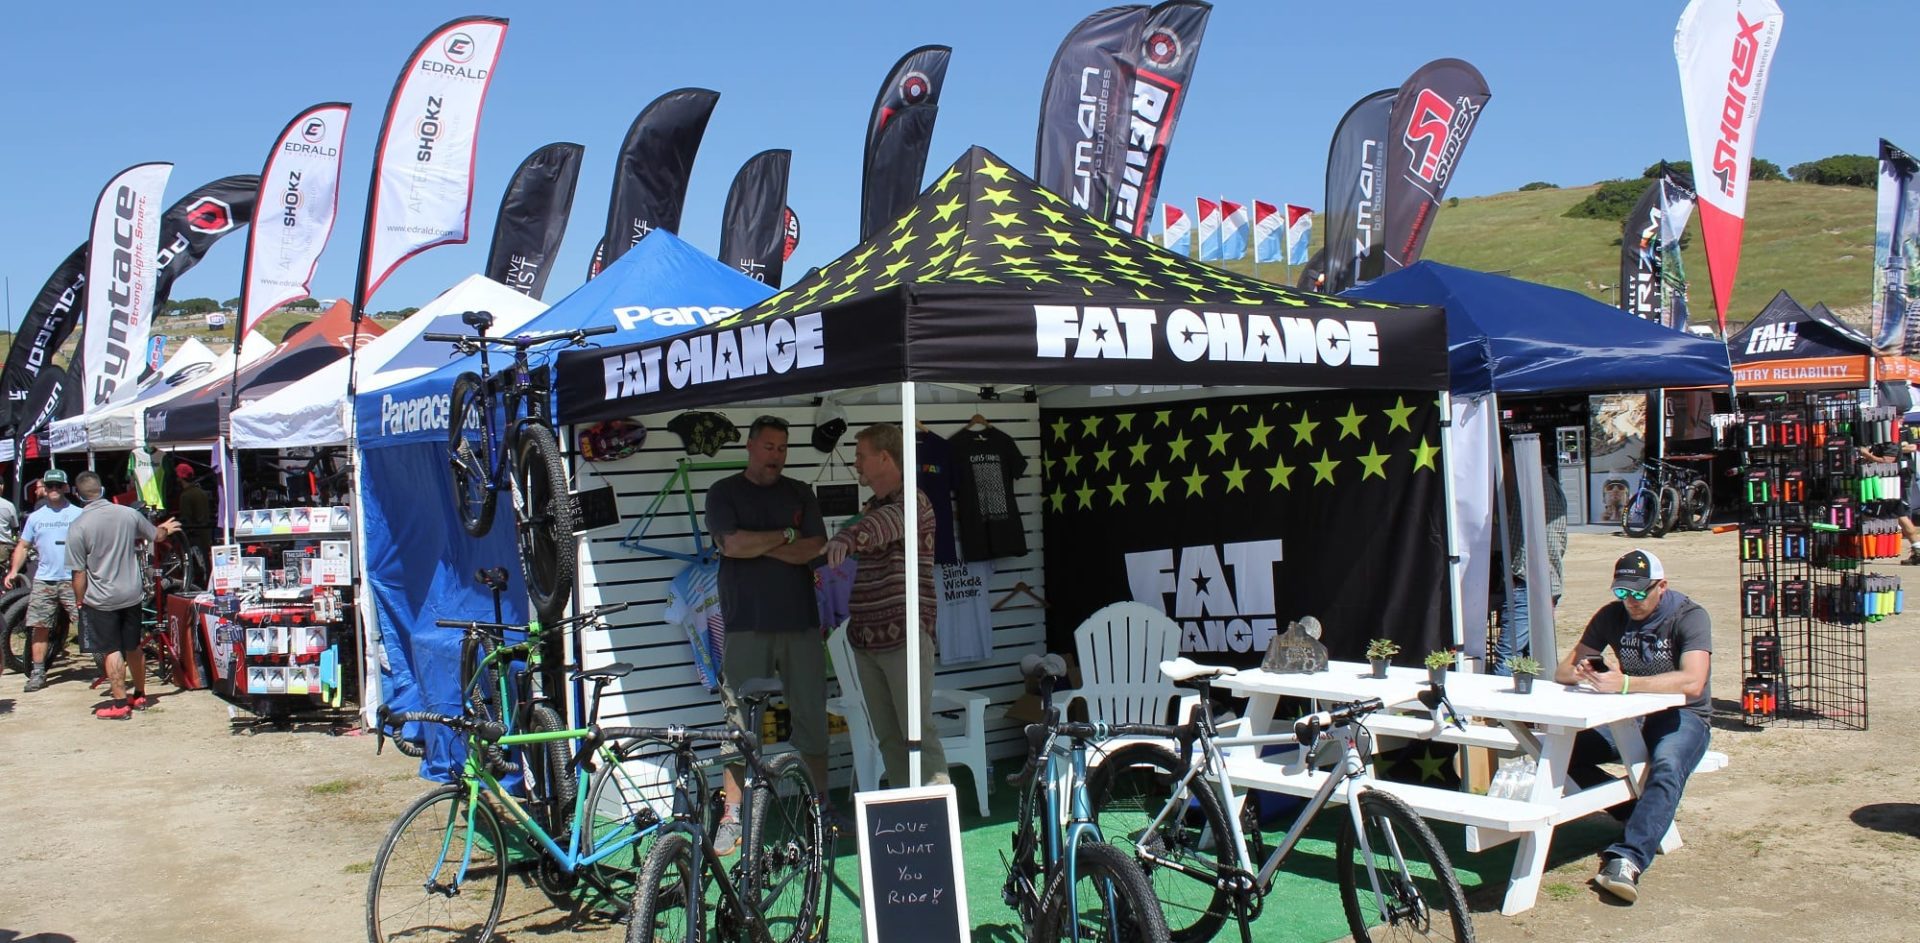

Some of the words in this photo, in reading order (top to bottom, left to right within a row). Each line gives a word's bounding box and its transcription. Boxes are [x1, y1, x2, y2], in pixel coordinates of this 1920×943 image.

[421, 60, 488, 80] EDRALD
[1093, 69, 1112, 154] boundless
[285, 142, 337, 157] EDRALD
[134, 195, 147, 240] Smart.
[133, 242, 145, 281] Light.
[1637, 206, 1662, 320] RIZM
[130, 282, 144, 327] Strong.
[1628, 275, 1637, 315] AKLEY
[1033, 305, 1158, 360] FAT
[1166, 308, 1380, 367] CHANCE
[1745, 336, 1797, 355] LINE
[1750, 321, 1799, 341] FALL
[603, 345, 664, 401] FAT
[666, 312, 825, 390] CHANCE
[1773, 365, 1848, 380] RELIABILITY
[1124, 539, 1283, 618] FAT
[1178, 617, 1279, 653] ANCE
[874, 818, 928, 836] LOVE
[887, 843, 935, 855] WHAT
[888, 887, 943, 904] RIDE!
[1041, 868, 1065, 913] RITCHEY
